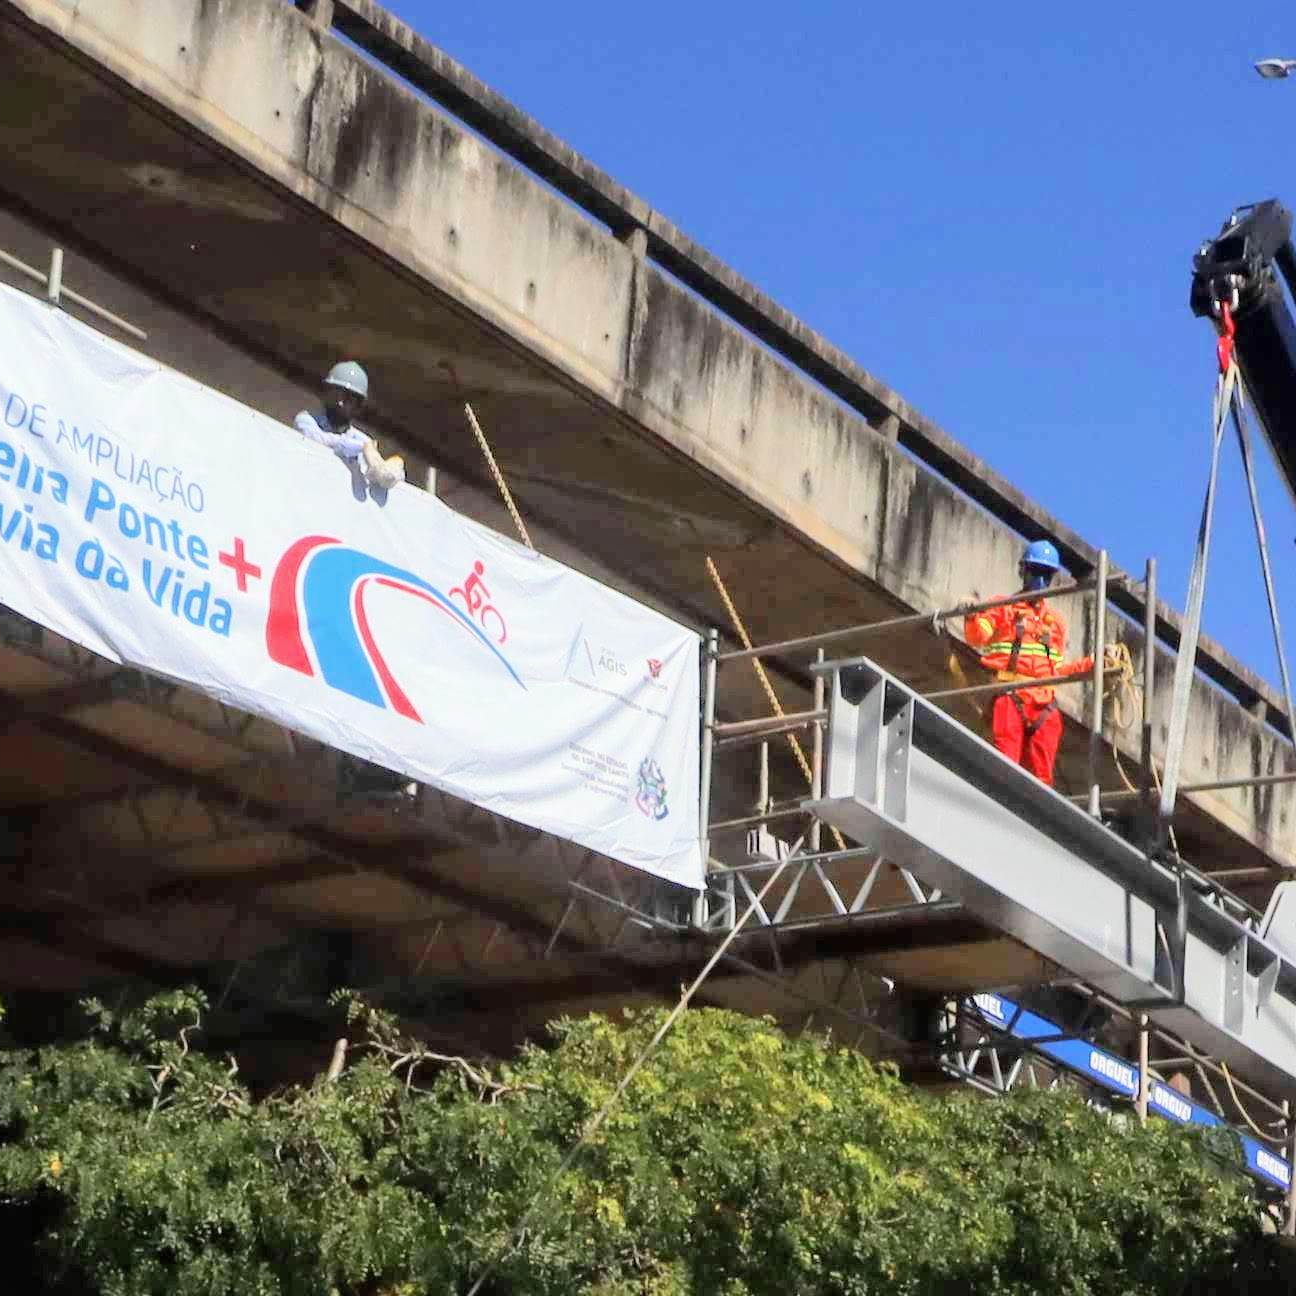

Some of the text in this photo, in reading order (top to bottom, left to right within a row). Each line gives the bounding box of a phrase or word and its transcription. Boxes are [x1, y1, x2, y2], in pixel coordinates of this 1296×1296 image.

[4, 392, 47, 438] DE
[56, 418, 205, 514] AMPLIAÇÃO
[84, 476, 210, 570] Ponte
[142, 557, 233, 639] Vida
[1089, 1049, 1136, 1091] ORGUEL
[1256, 1148, 1292, 1187] ORGUEL
